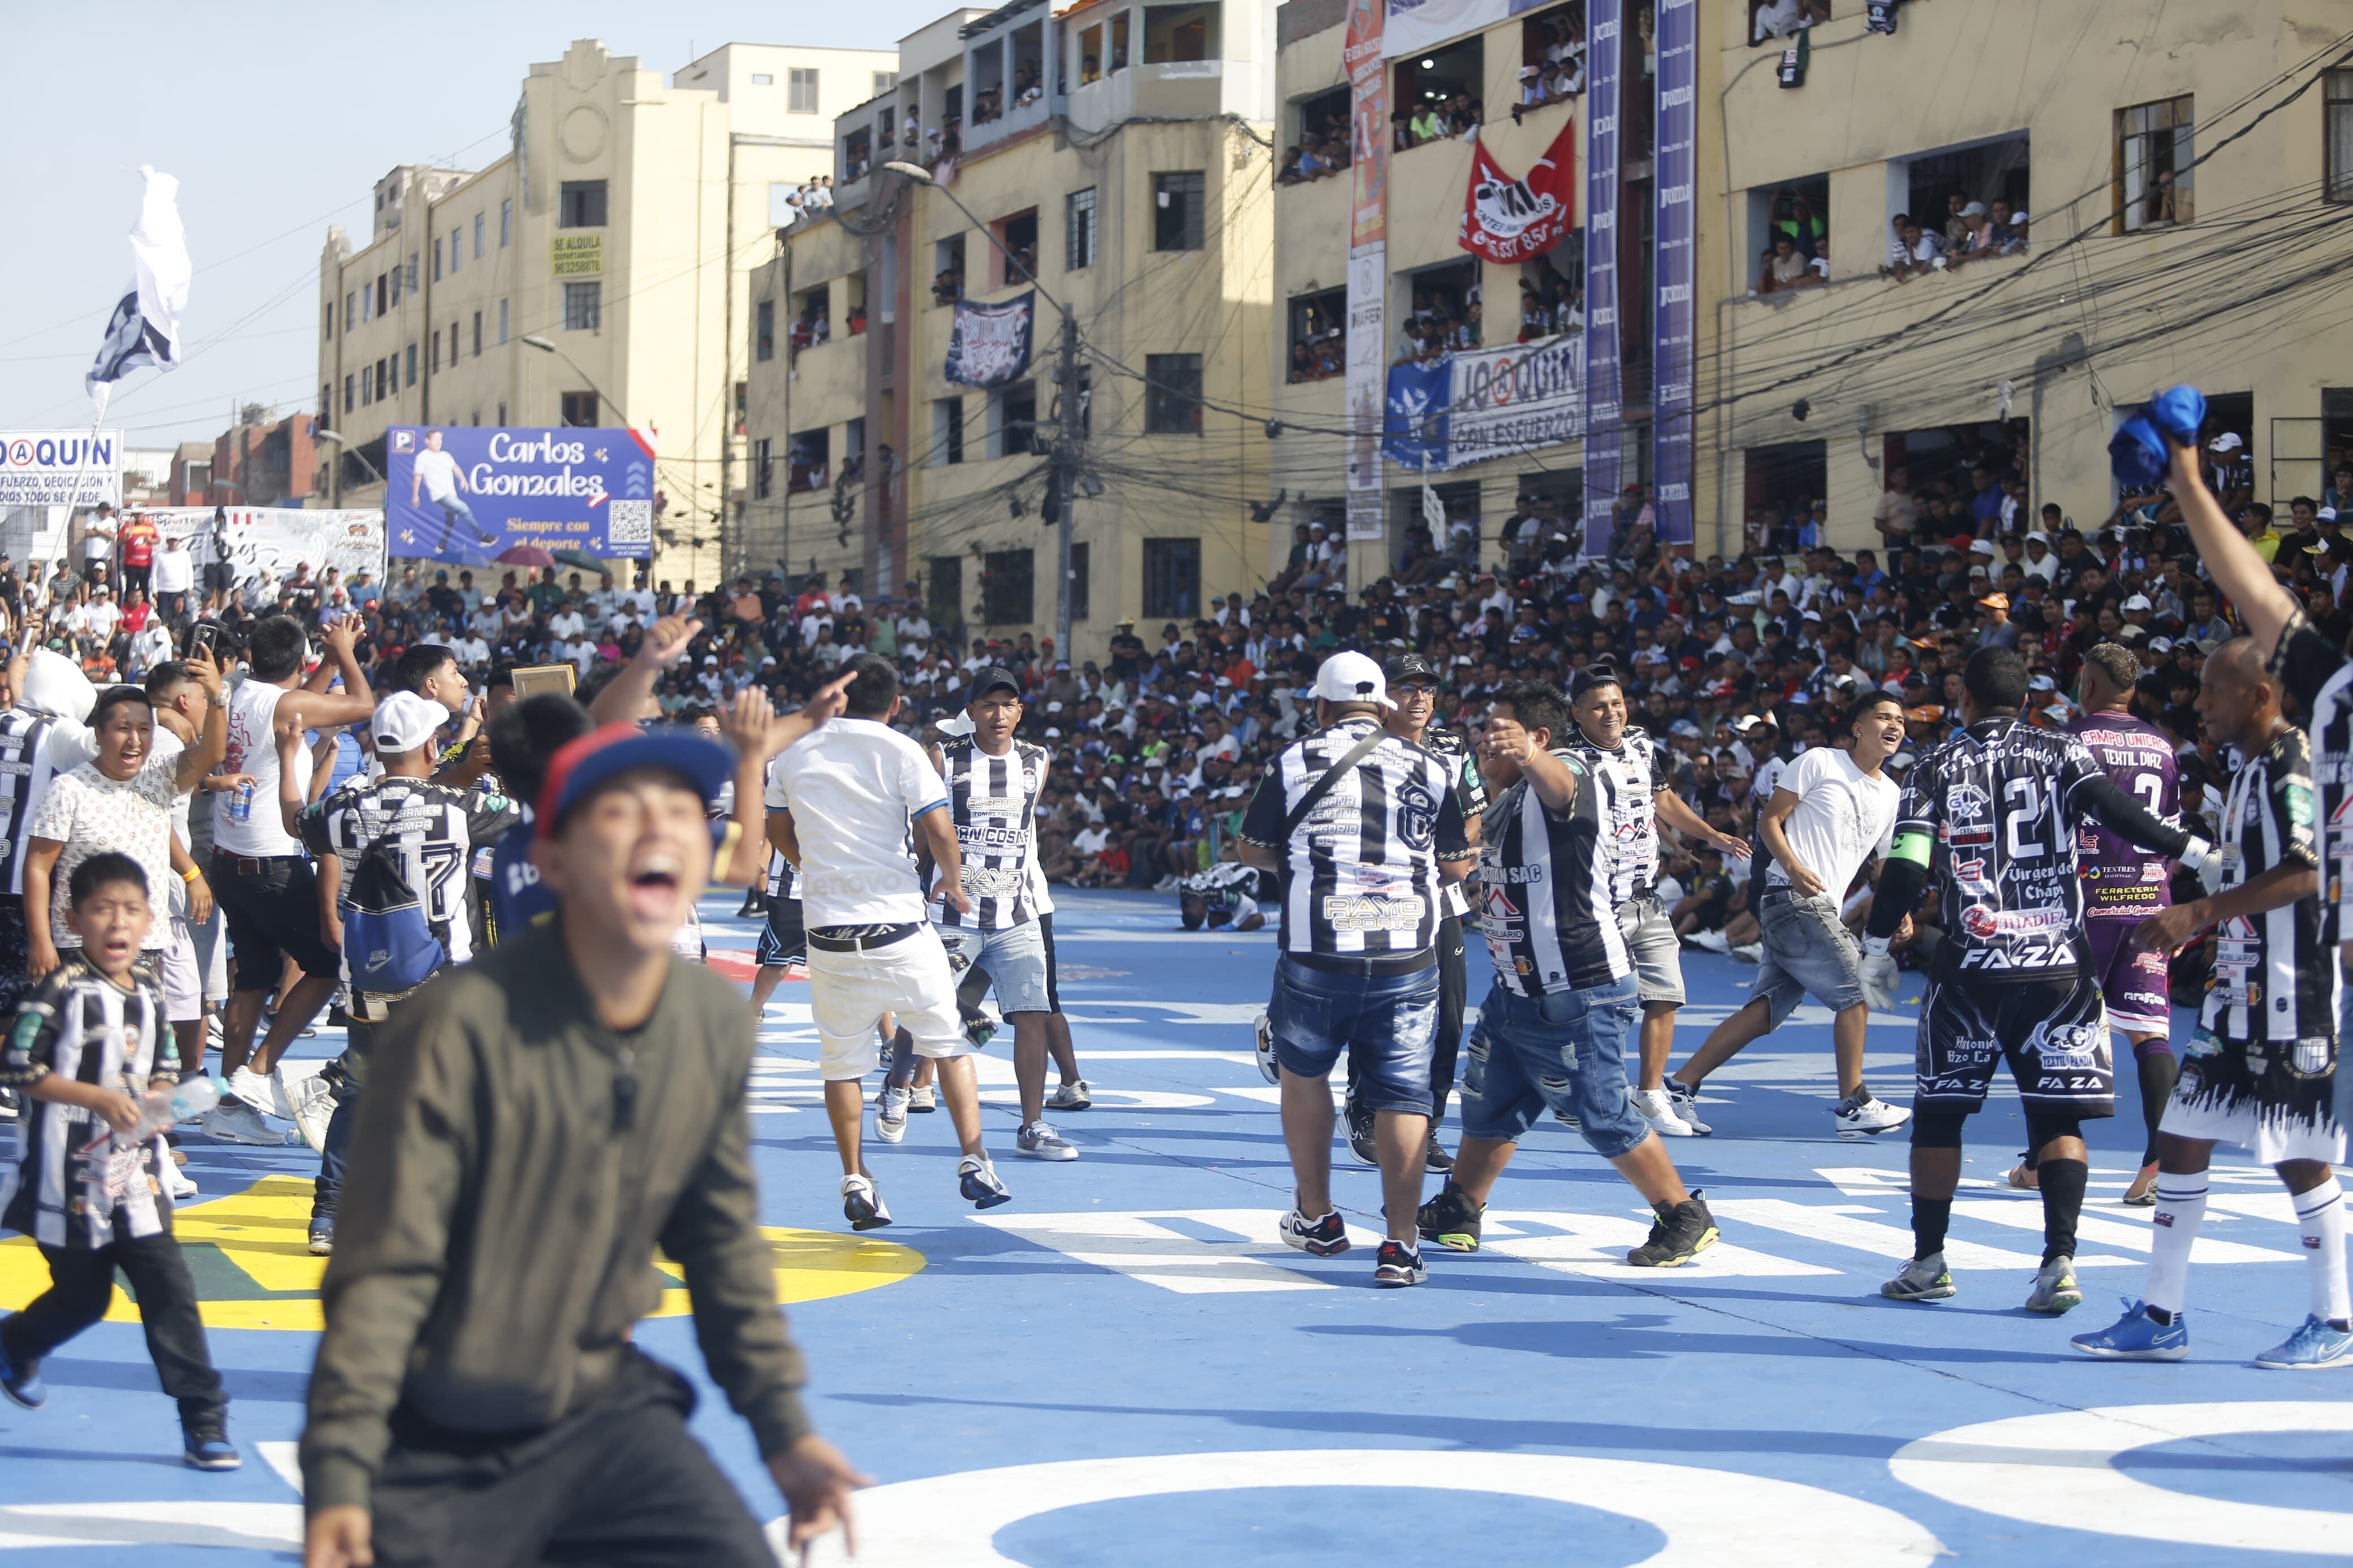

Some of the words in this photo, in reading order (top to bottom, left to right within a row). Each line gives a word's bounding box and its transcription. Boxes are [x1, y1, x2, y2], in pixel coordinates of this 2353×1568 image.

[555, 238, 564, 250] SE
[567, 236, 601, 249] ALQUILA
[555, 251, 601, 260] DEPARTAMENTO
[1457, 342, 1578, 412] JOAQUIN
[1495, 410, 1575, 445] ESFUERZO
[489, 431, 585, 464] Carlos
[107, 476, 112, 486] Y
[469, 465, 604, 497] Gonzales
[25, 491, 50, 502] TODO
[54, 491, 66, 502] SE
[506, 518, 562, 533] Siempre
[566, 521, 589, 531] con
[531, 537, 581, 550] deporte
[1305, 738, 1359, 749] ADRIAN
[2082, 730, 2124, 746] CAMPO
[1961, 747, 2005, 768] Amigo
[2103, 748, 2139, 766] TEXTIL
[2140, 751, 2162, 769] DIAZ
[969, 798, 985, 809] EL
[986, 799, 1025, 810] BONDY
[2004, 776, 2067, 858] 21
[388, 819, 433, 833] PAMPA
[1509, 864, 1542, 884] SAC
[2009, 866, 2054, 882] Virgen
[2058, 862, 2073, 876] de
[2026, 882, 2065, 900] Chapi
[1326, 897, 1425, 917] RAYO
[2088, 906, 2132, 917] Comercial
[1335, 918, 1418, 929] SPORTS
[2070, 1055, 2095, 1068] PANDA
